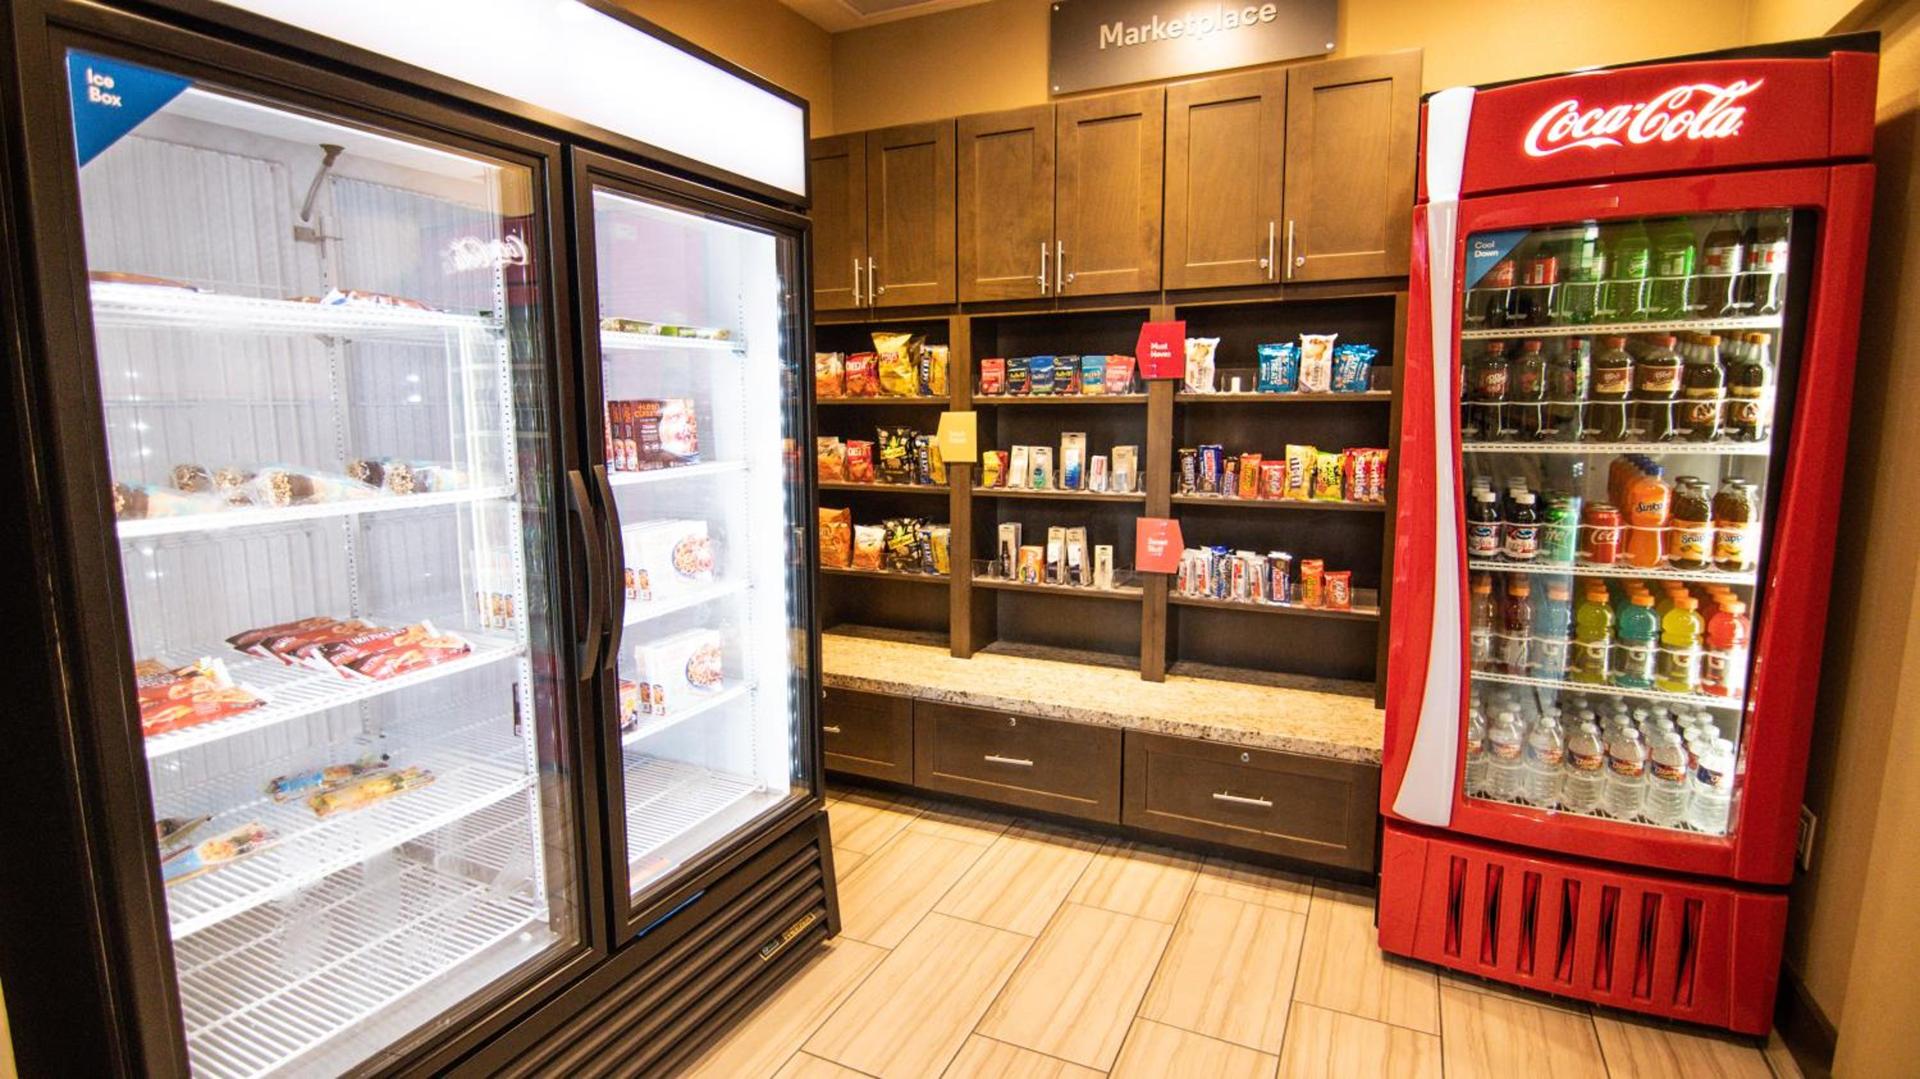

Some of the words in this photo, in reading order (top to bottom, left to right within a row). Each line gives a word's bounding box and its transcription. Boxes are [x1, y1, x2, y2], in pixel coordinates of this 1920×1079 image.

[1100, 3, 1277, 49] Marketplace
[86, 68, 115, 89] Ice
[89, 86, 122, 107] Box
[1524, 79, 1764, 157] Coca-Cola
[1474, 250, 1499, 258] Down
[1475, 241, 1495, 249] Cool
